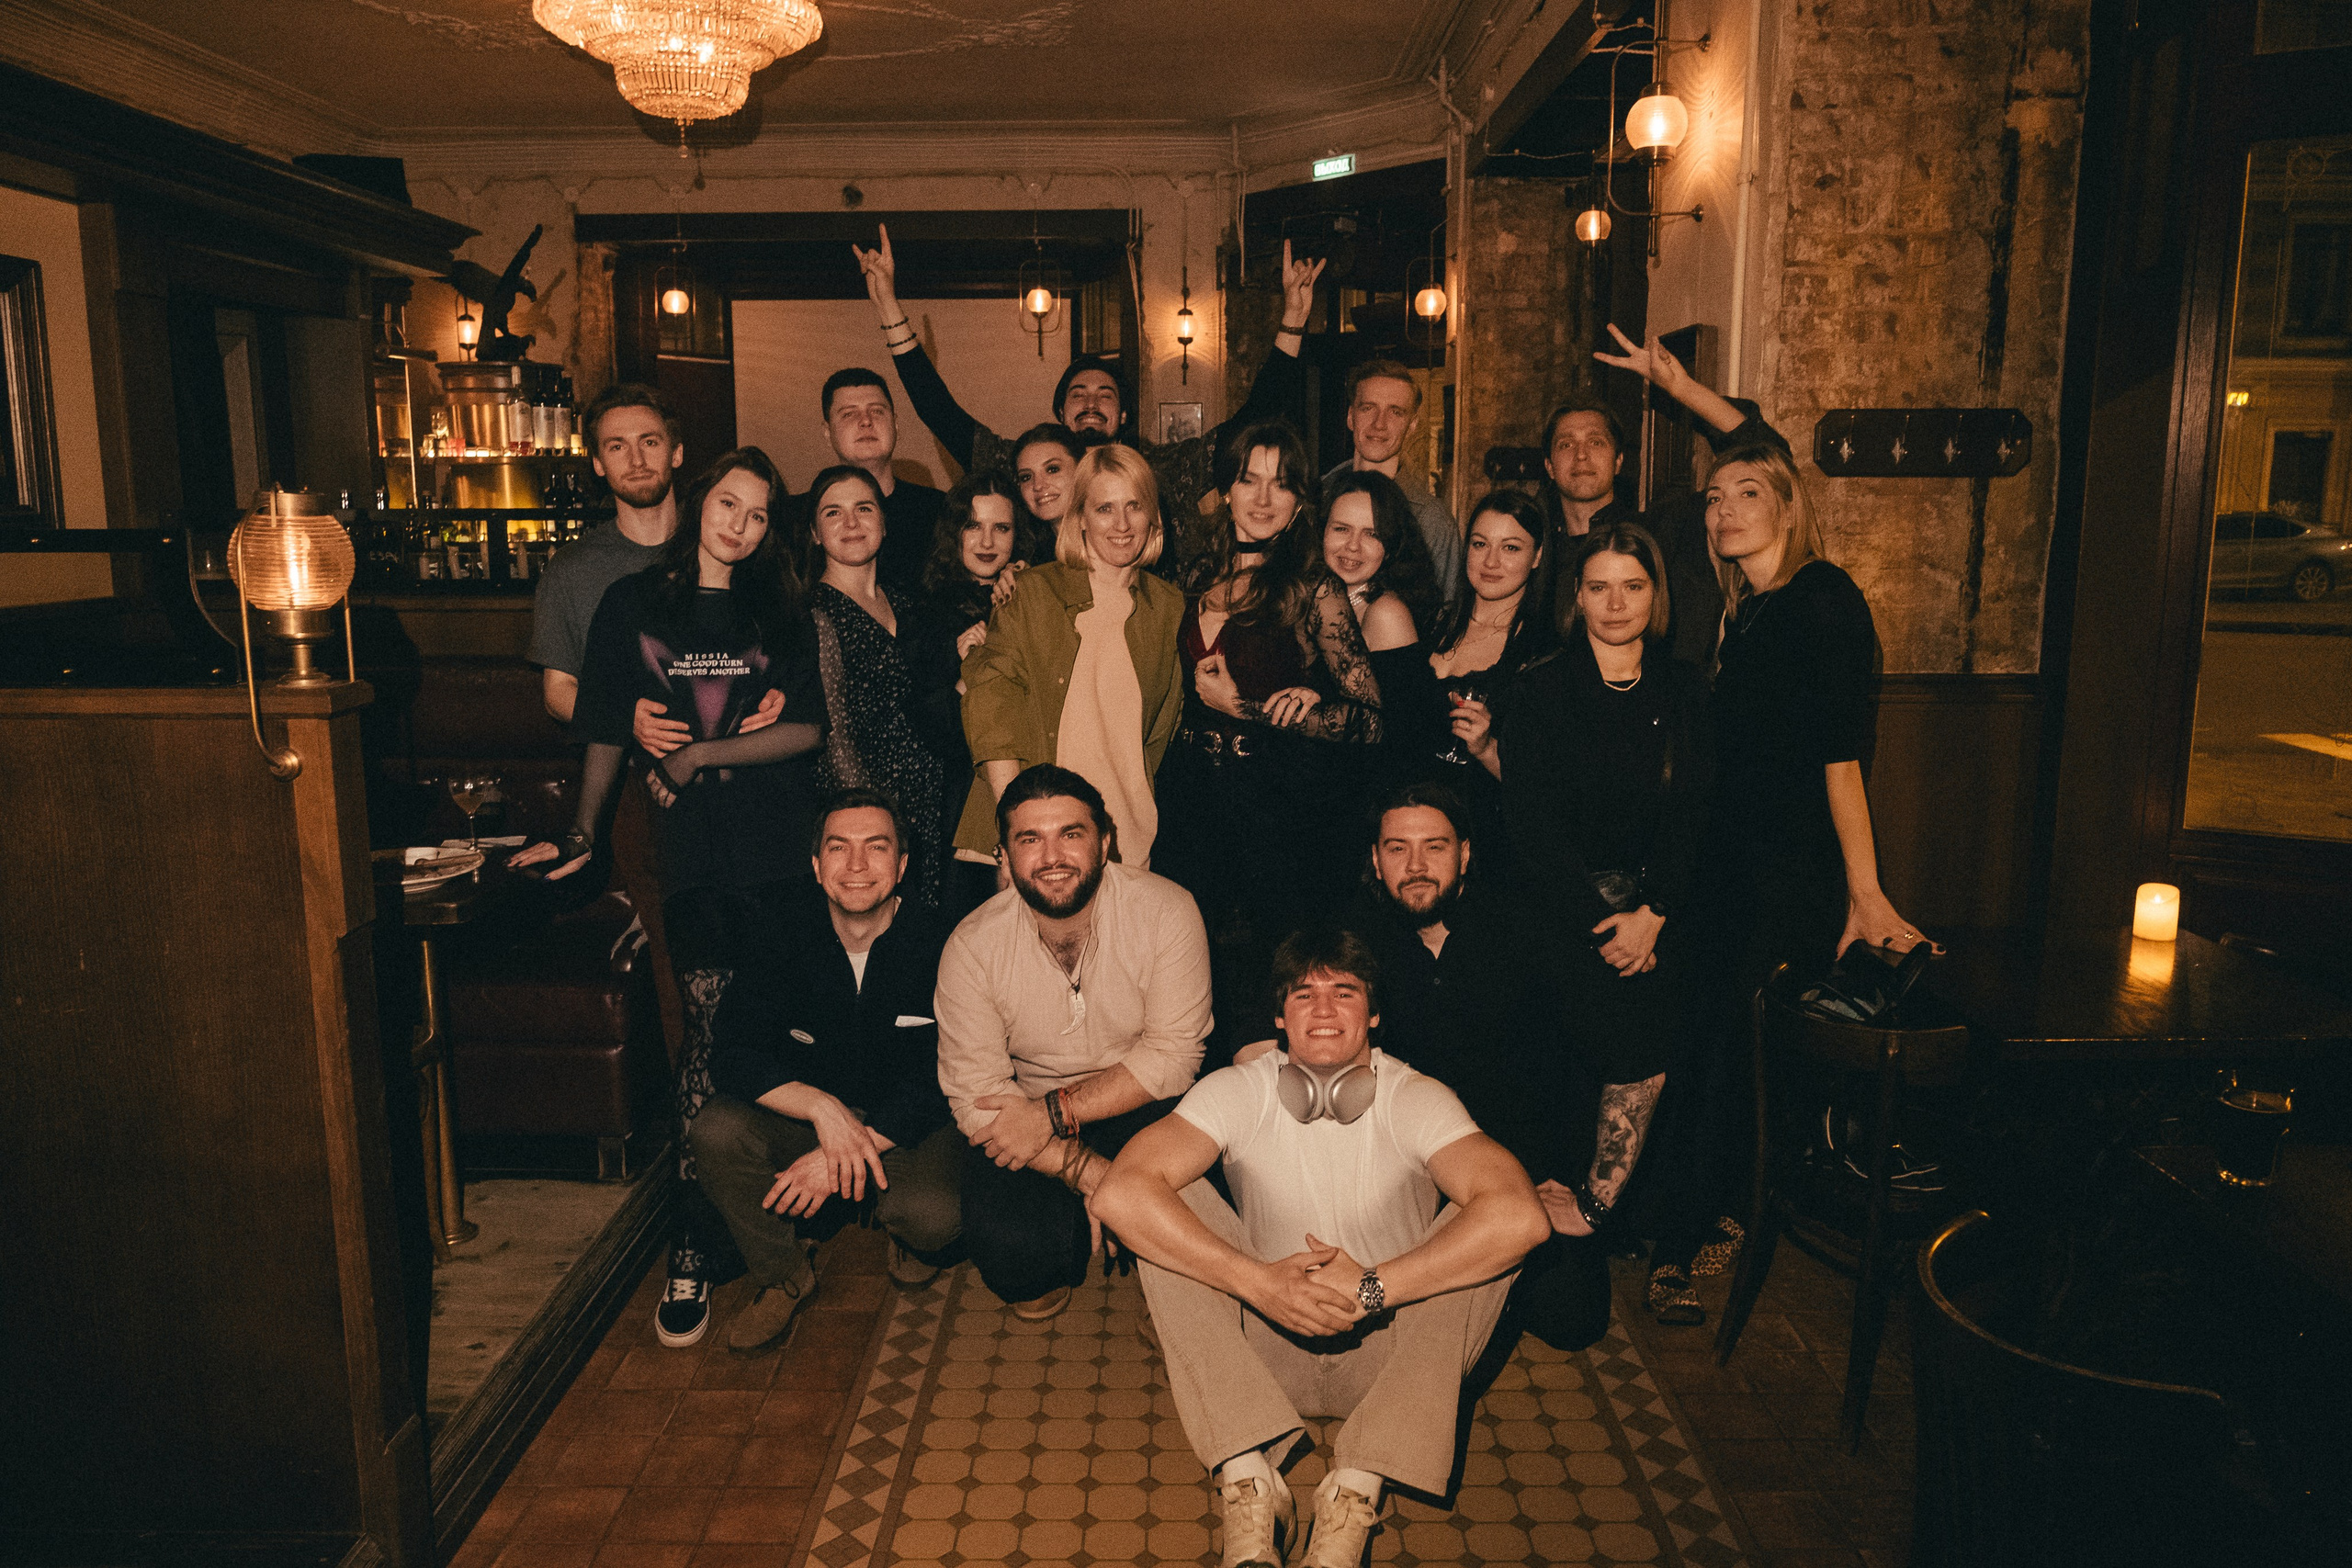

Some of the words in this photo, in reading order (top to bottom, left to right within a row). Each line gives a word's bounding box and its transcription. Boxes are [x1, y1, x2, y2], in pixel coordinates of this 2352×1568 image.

[1314, 158, 1351, 177] ВЫХОД
[692, 660, 718, 668] GOOD
[668, 668, 707, 676] DESERVES
[709, 667, 751, 676] ANOTHER
